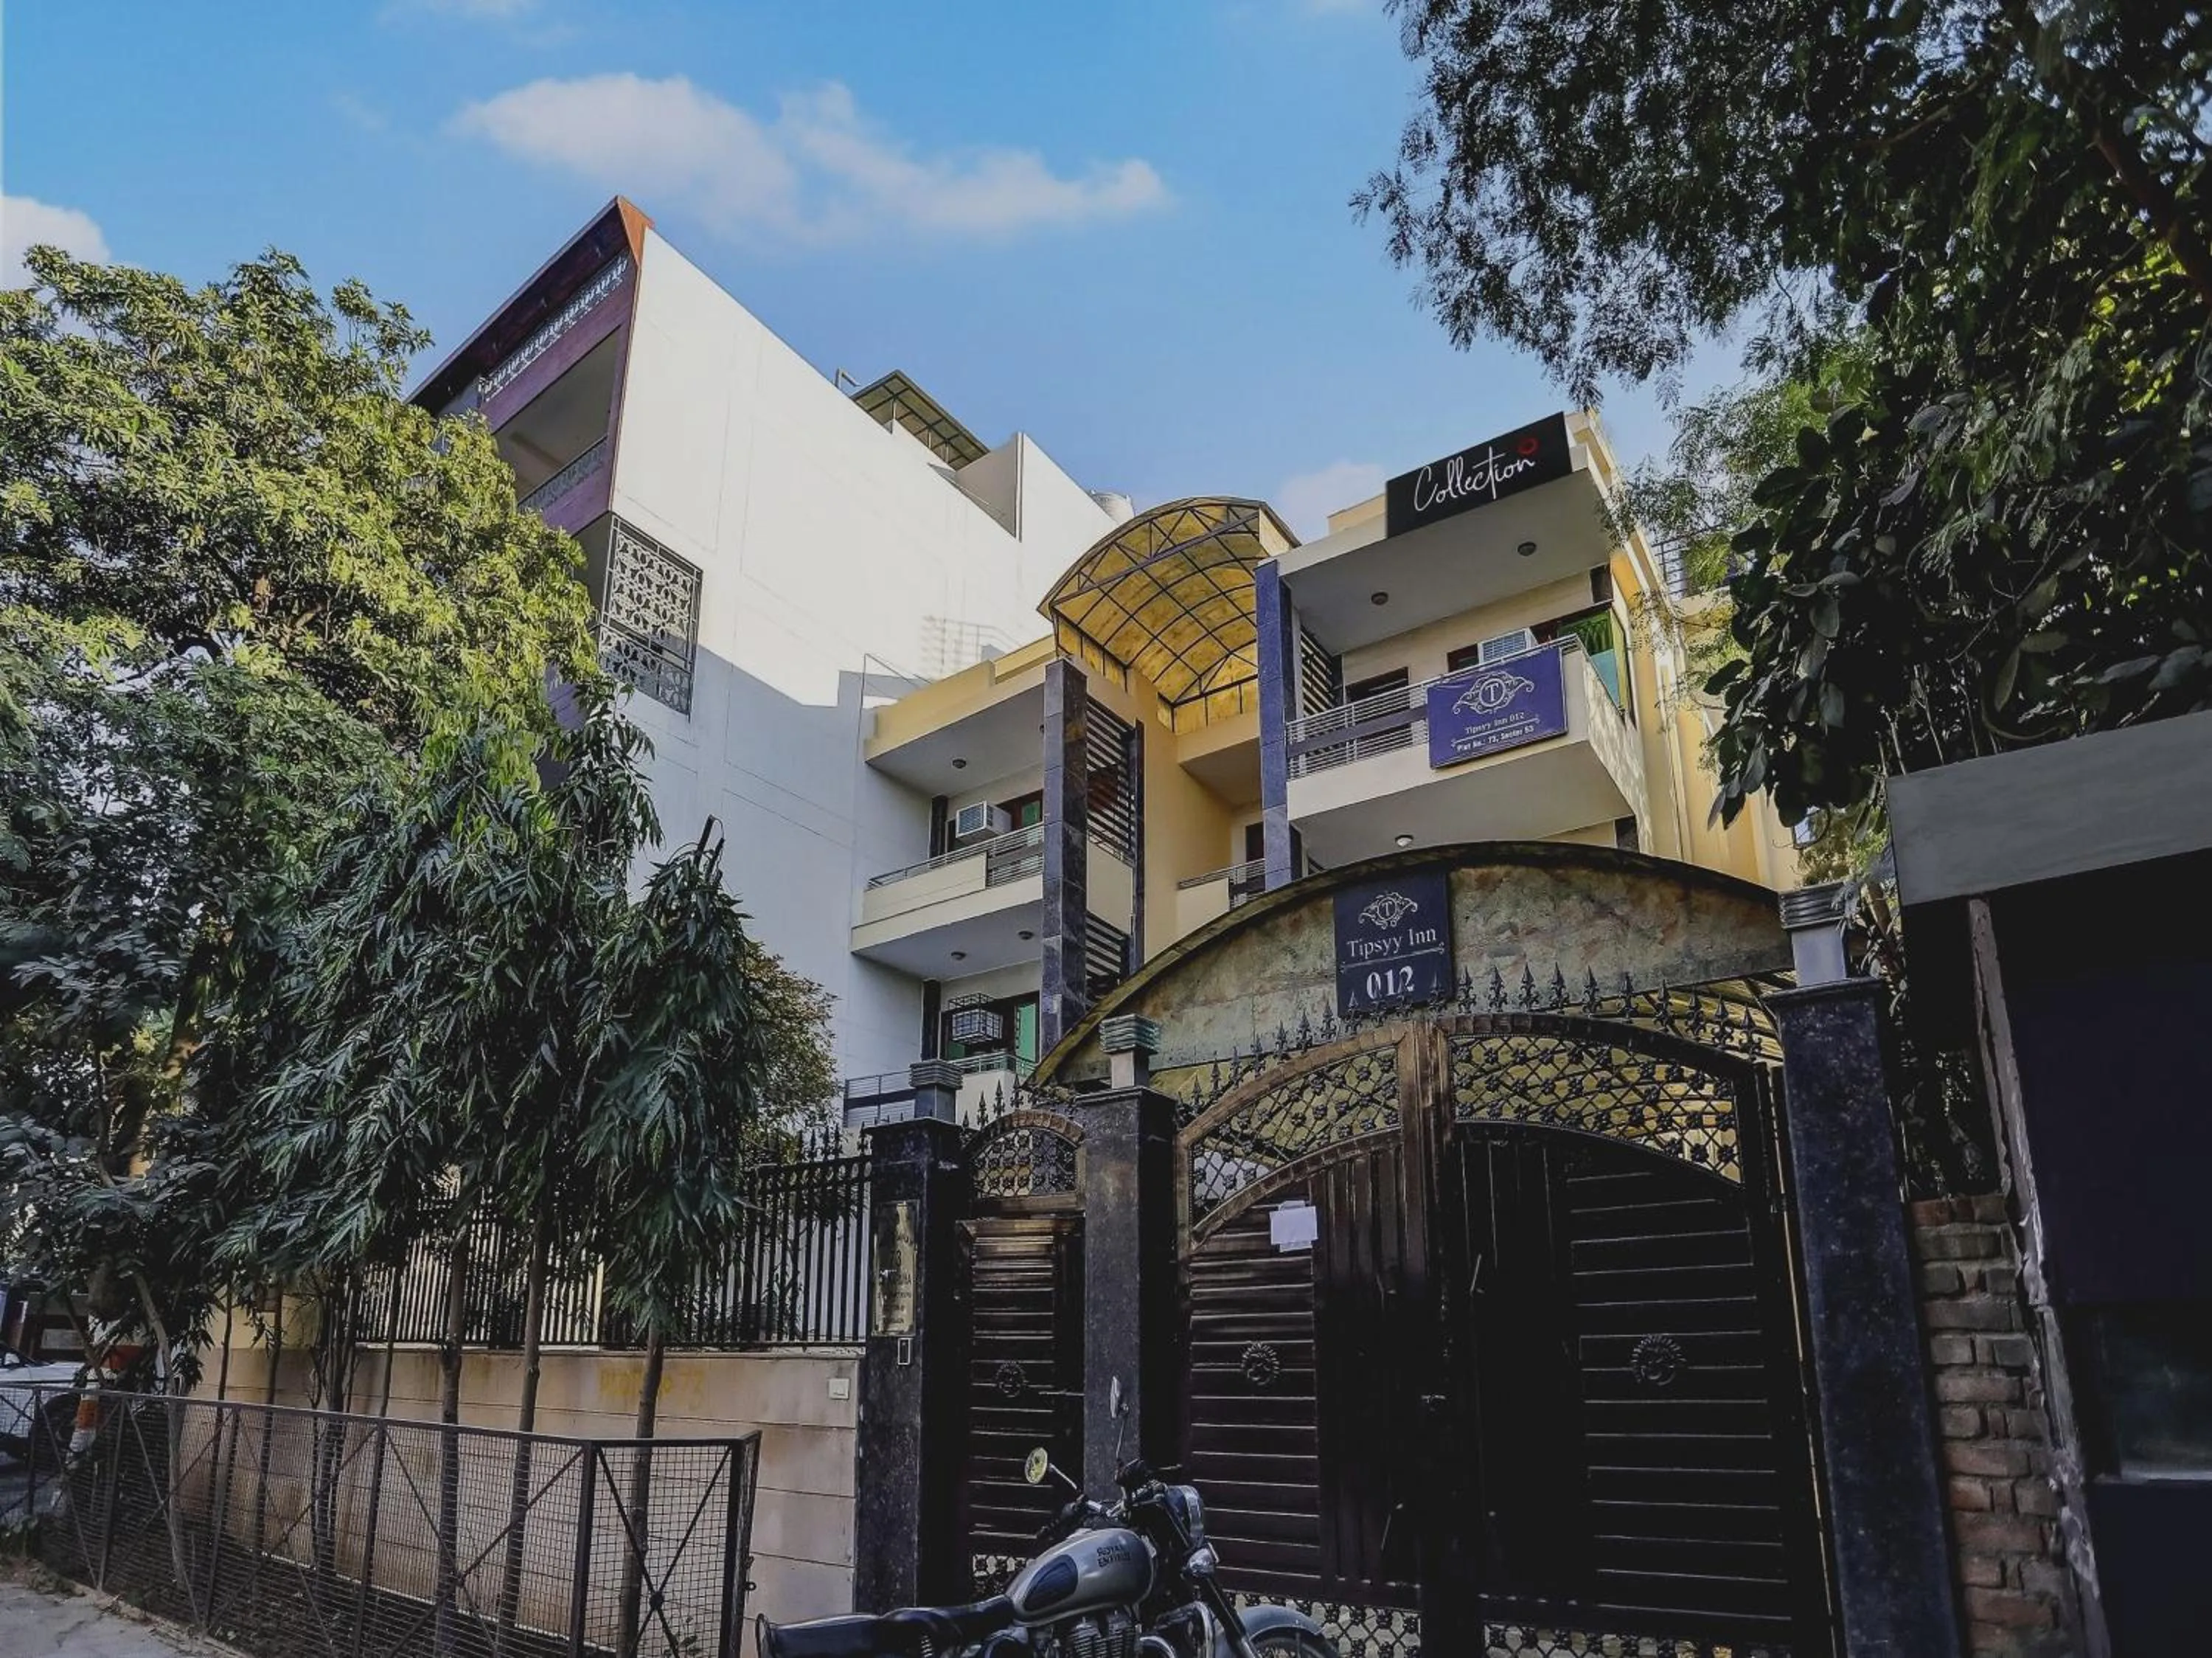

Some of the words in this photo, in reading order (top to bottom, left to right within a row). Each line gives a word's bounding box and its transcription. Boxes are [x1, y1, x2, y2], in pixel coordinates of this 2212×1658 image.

[1413, 445, 1535, 511] Collection
[1485, 682, 1499, 702] T
[1509, 712, 1525, 722] 012
[1381, 901, 1393, 917] T
[1346, 934, 1402, 959] Tipsyy
[1407, 928, 1437, 946] Inn
[1366, 965, 1415, 1000] 012
